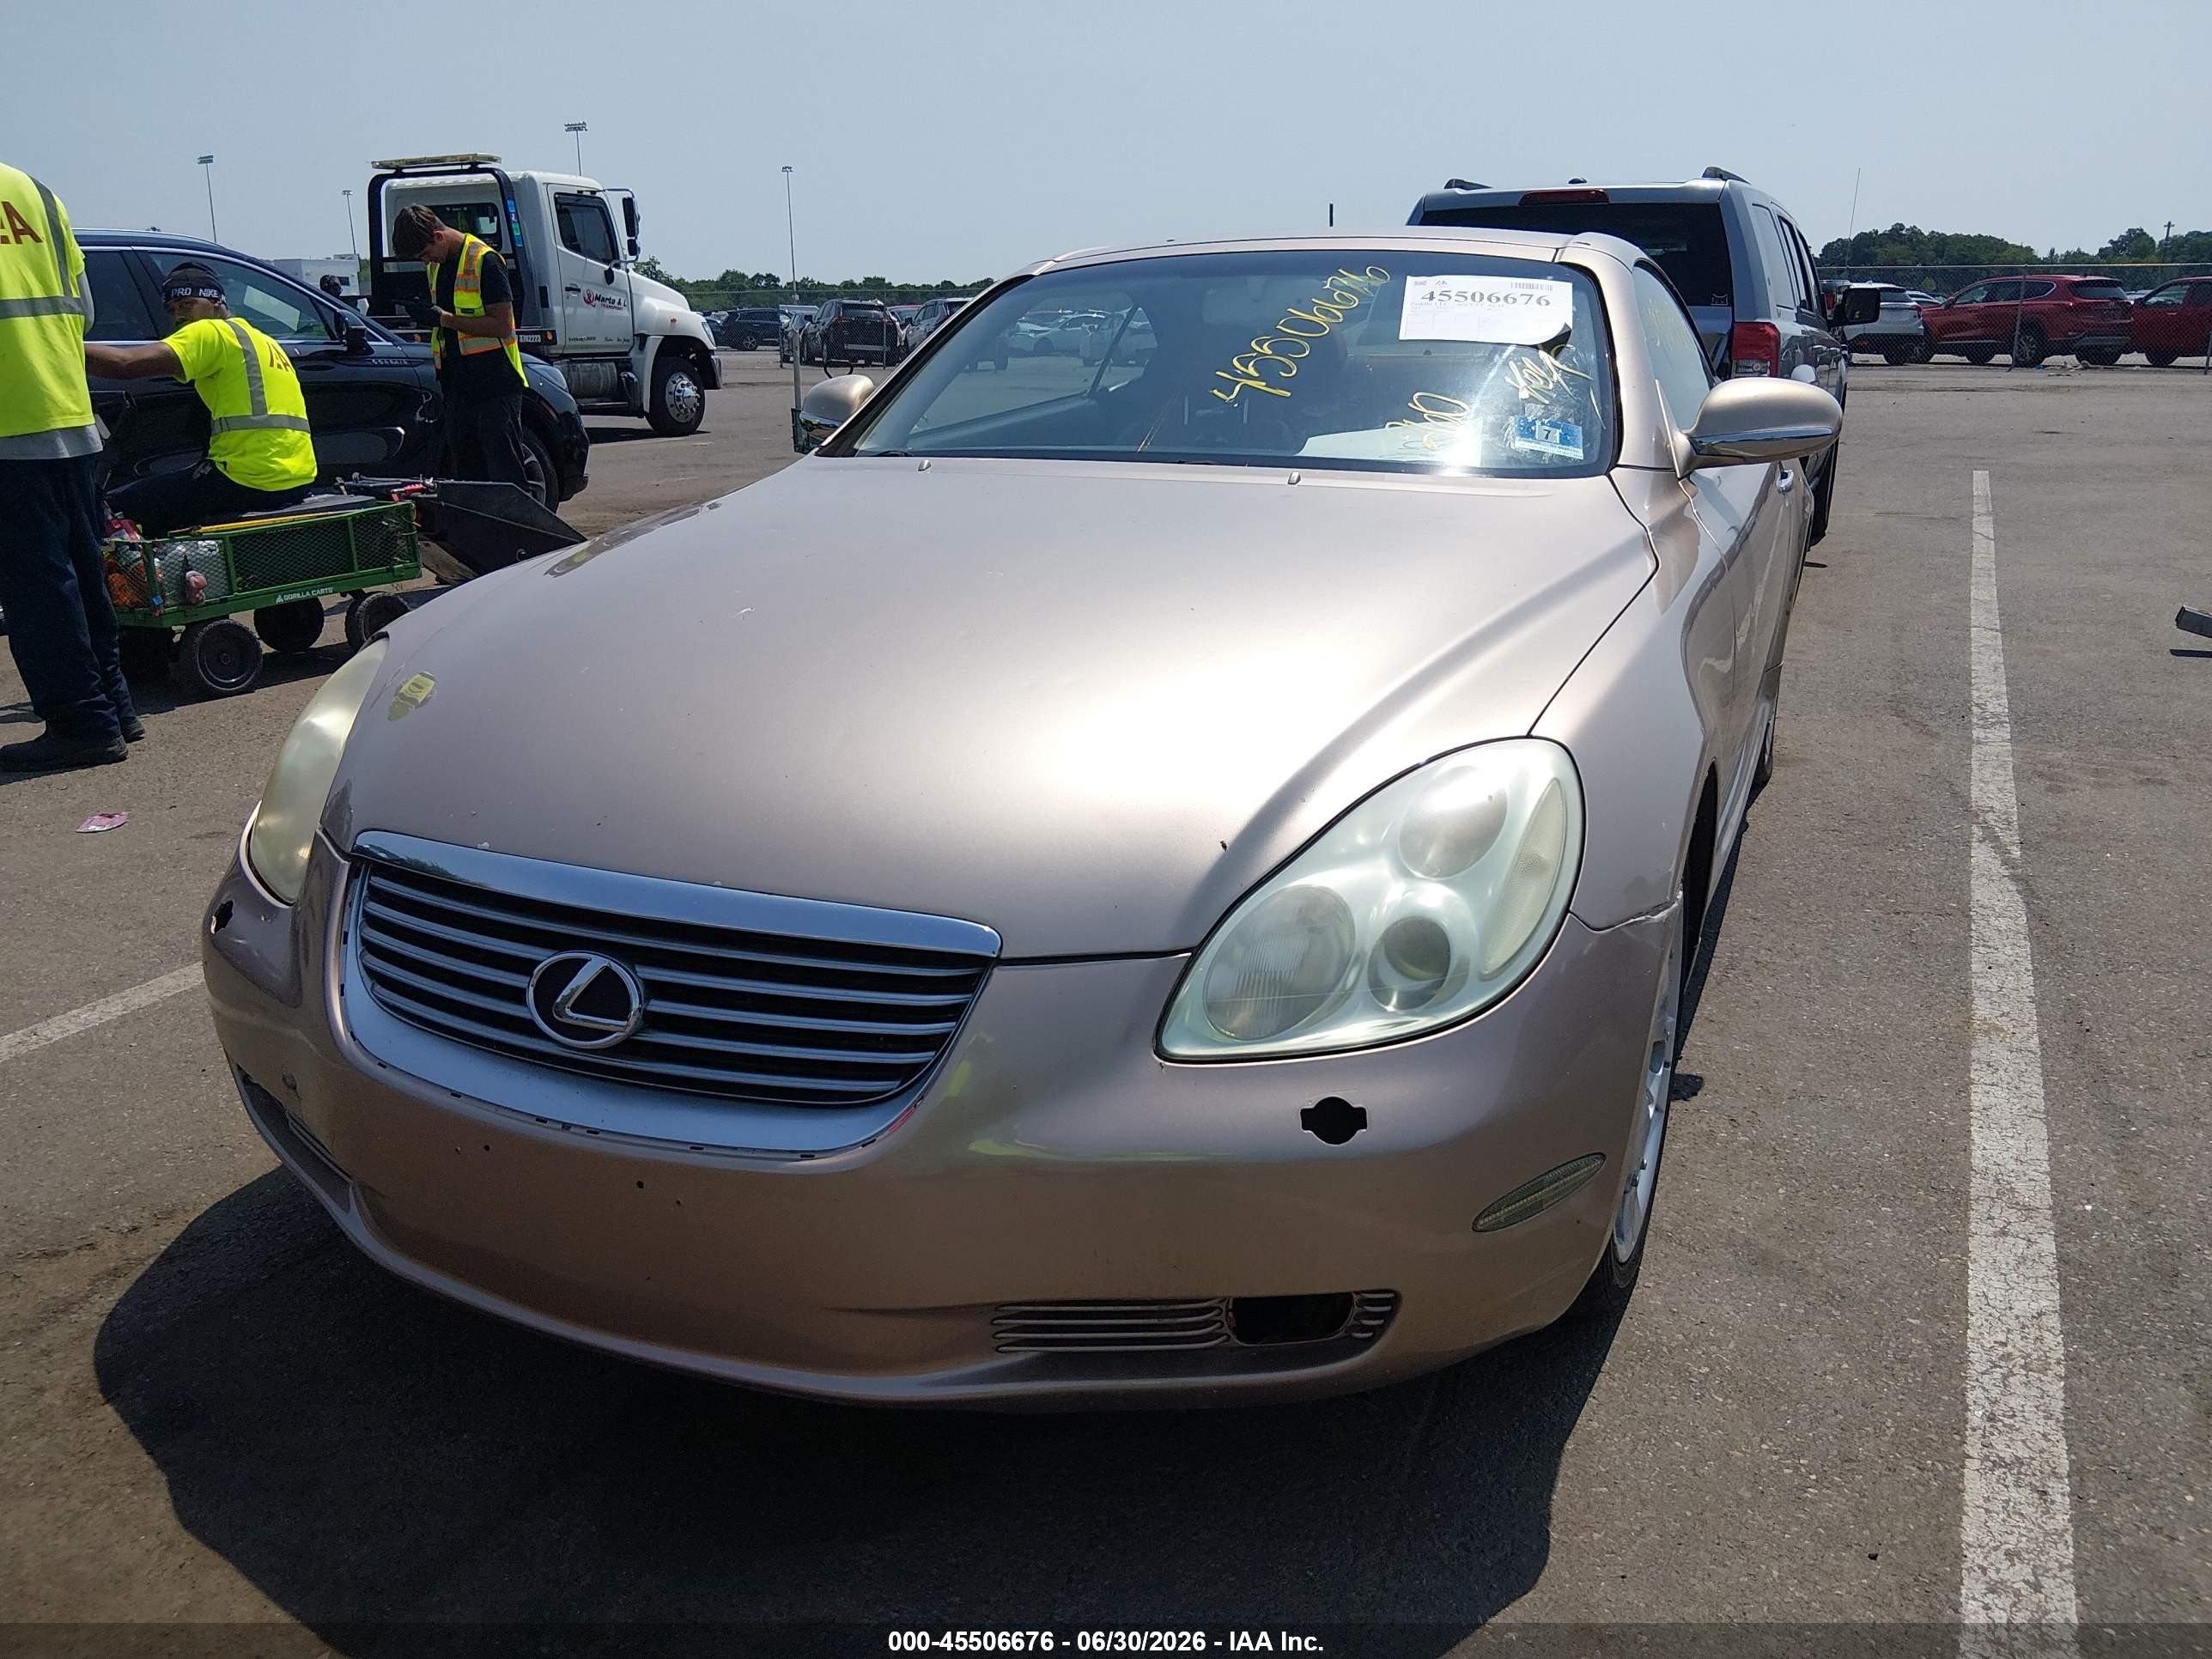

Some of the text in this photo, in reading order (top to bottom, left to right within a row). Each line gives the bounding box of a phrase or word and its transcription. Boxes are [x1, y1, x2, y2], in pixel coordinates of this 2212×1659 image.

[172, 288, 221, 298] PRO NIKE
[1421, 289, 1552, 307] 45506676
[1543, 429, 1552, 441] 7
[283, 586, 334, 601] GORILLA CARTS
